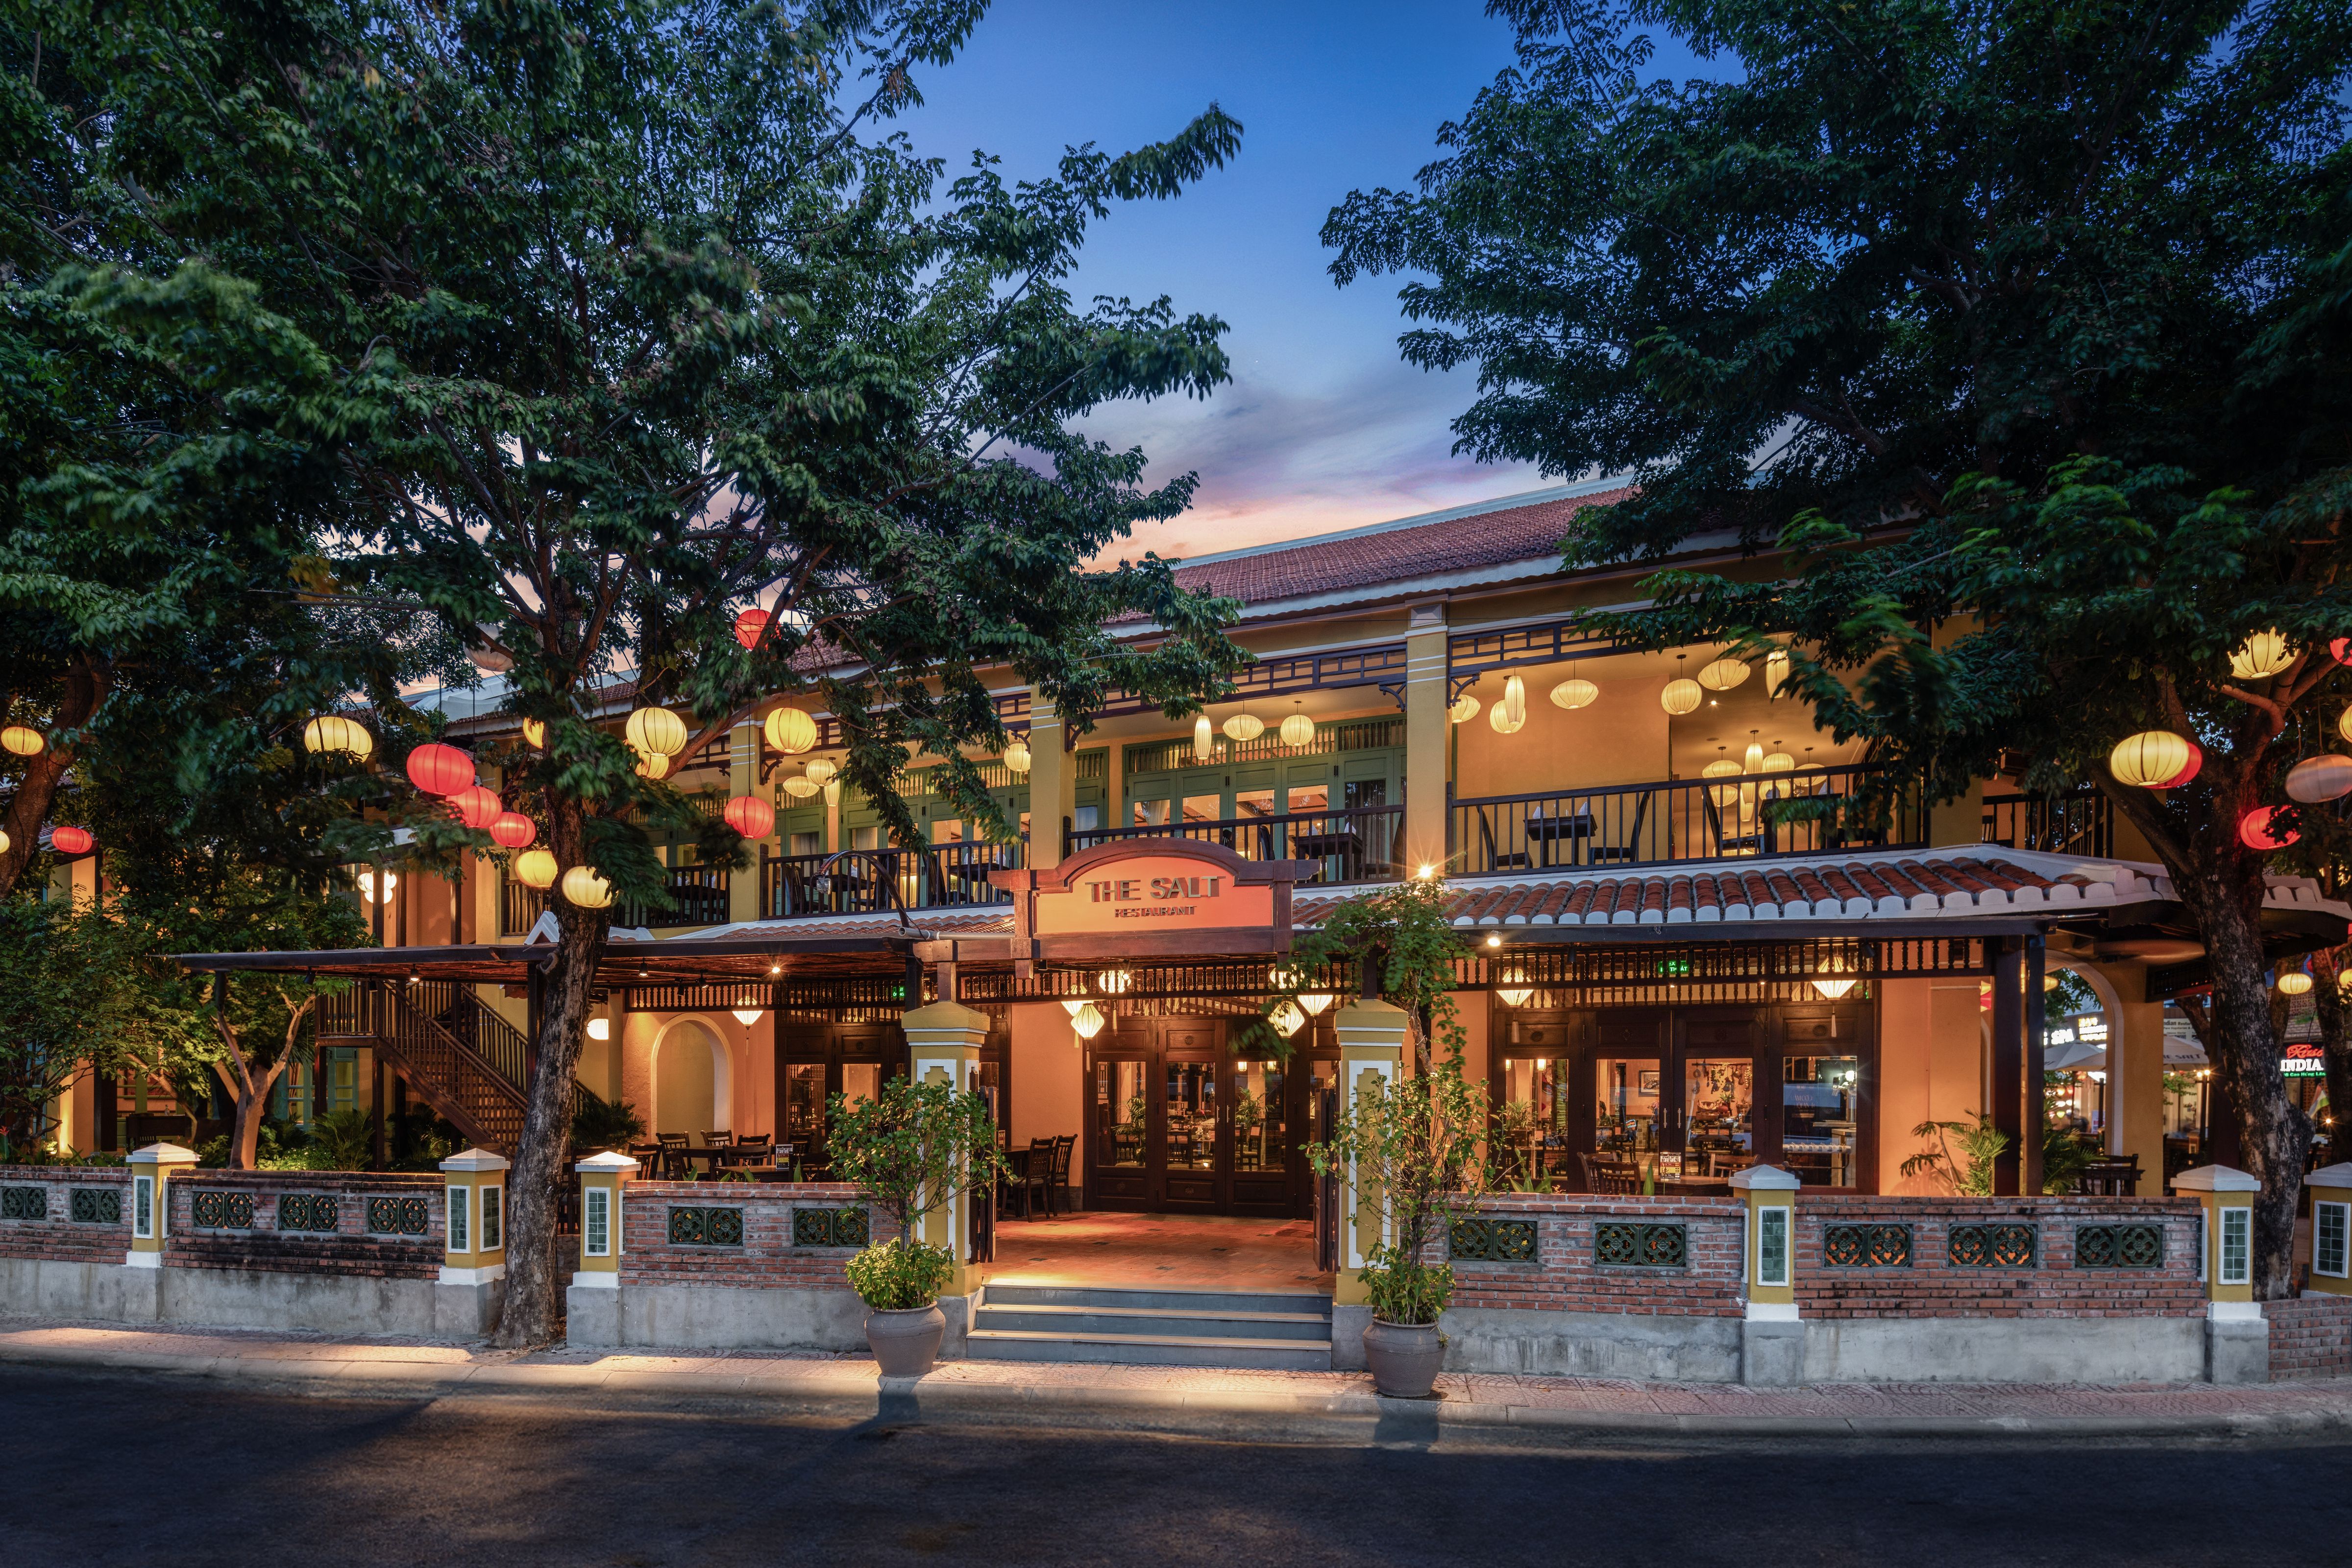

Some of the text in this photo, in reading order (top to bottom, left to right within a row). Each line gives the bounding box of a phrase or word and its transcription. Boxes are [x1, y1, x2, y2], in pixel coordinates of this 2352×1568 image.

[1084, 876, 1220, 902] THE SALT
[1114, 906, 1195, 917] RESTAURANT
[2280, 1059, 2324, 1072] INDIA
